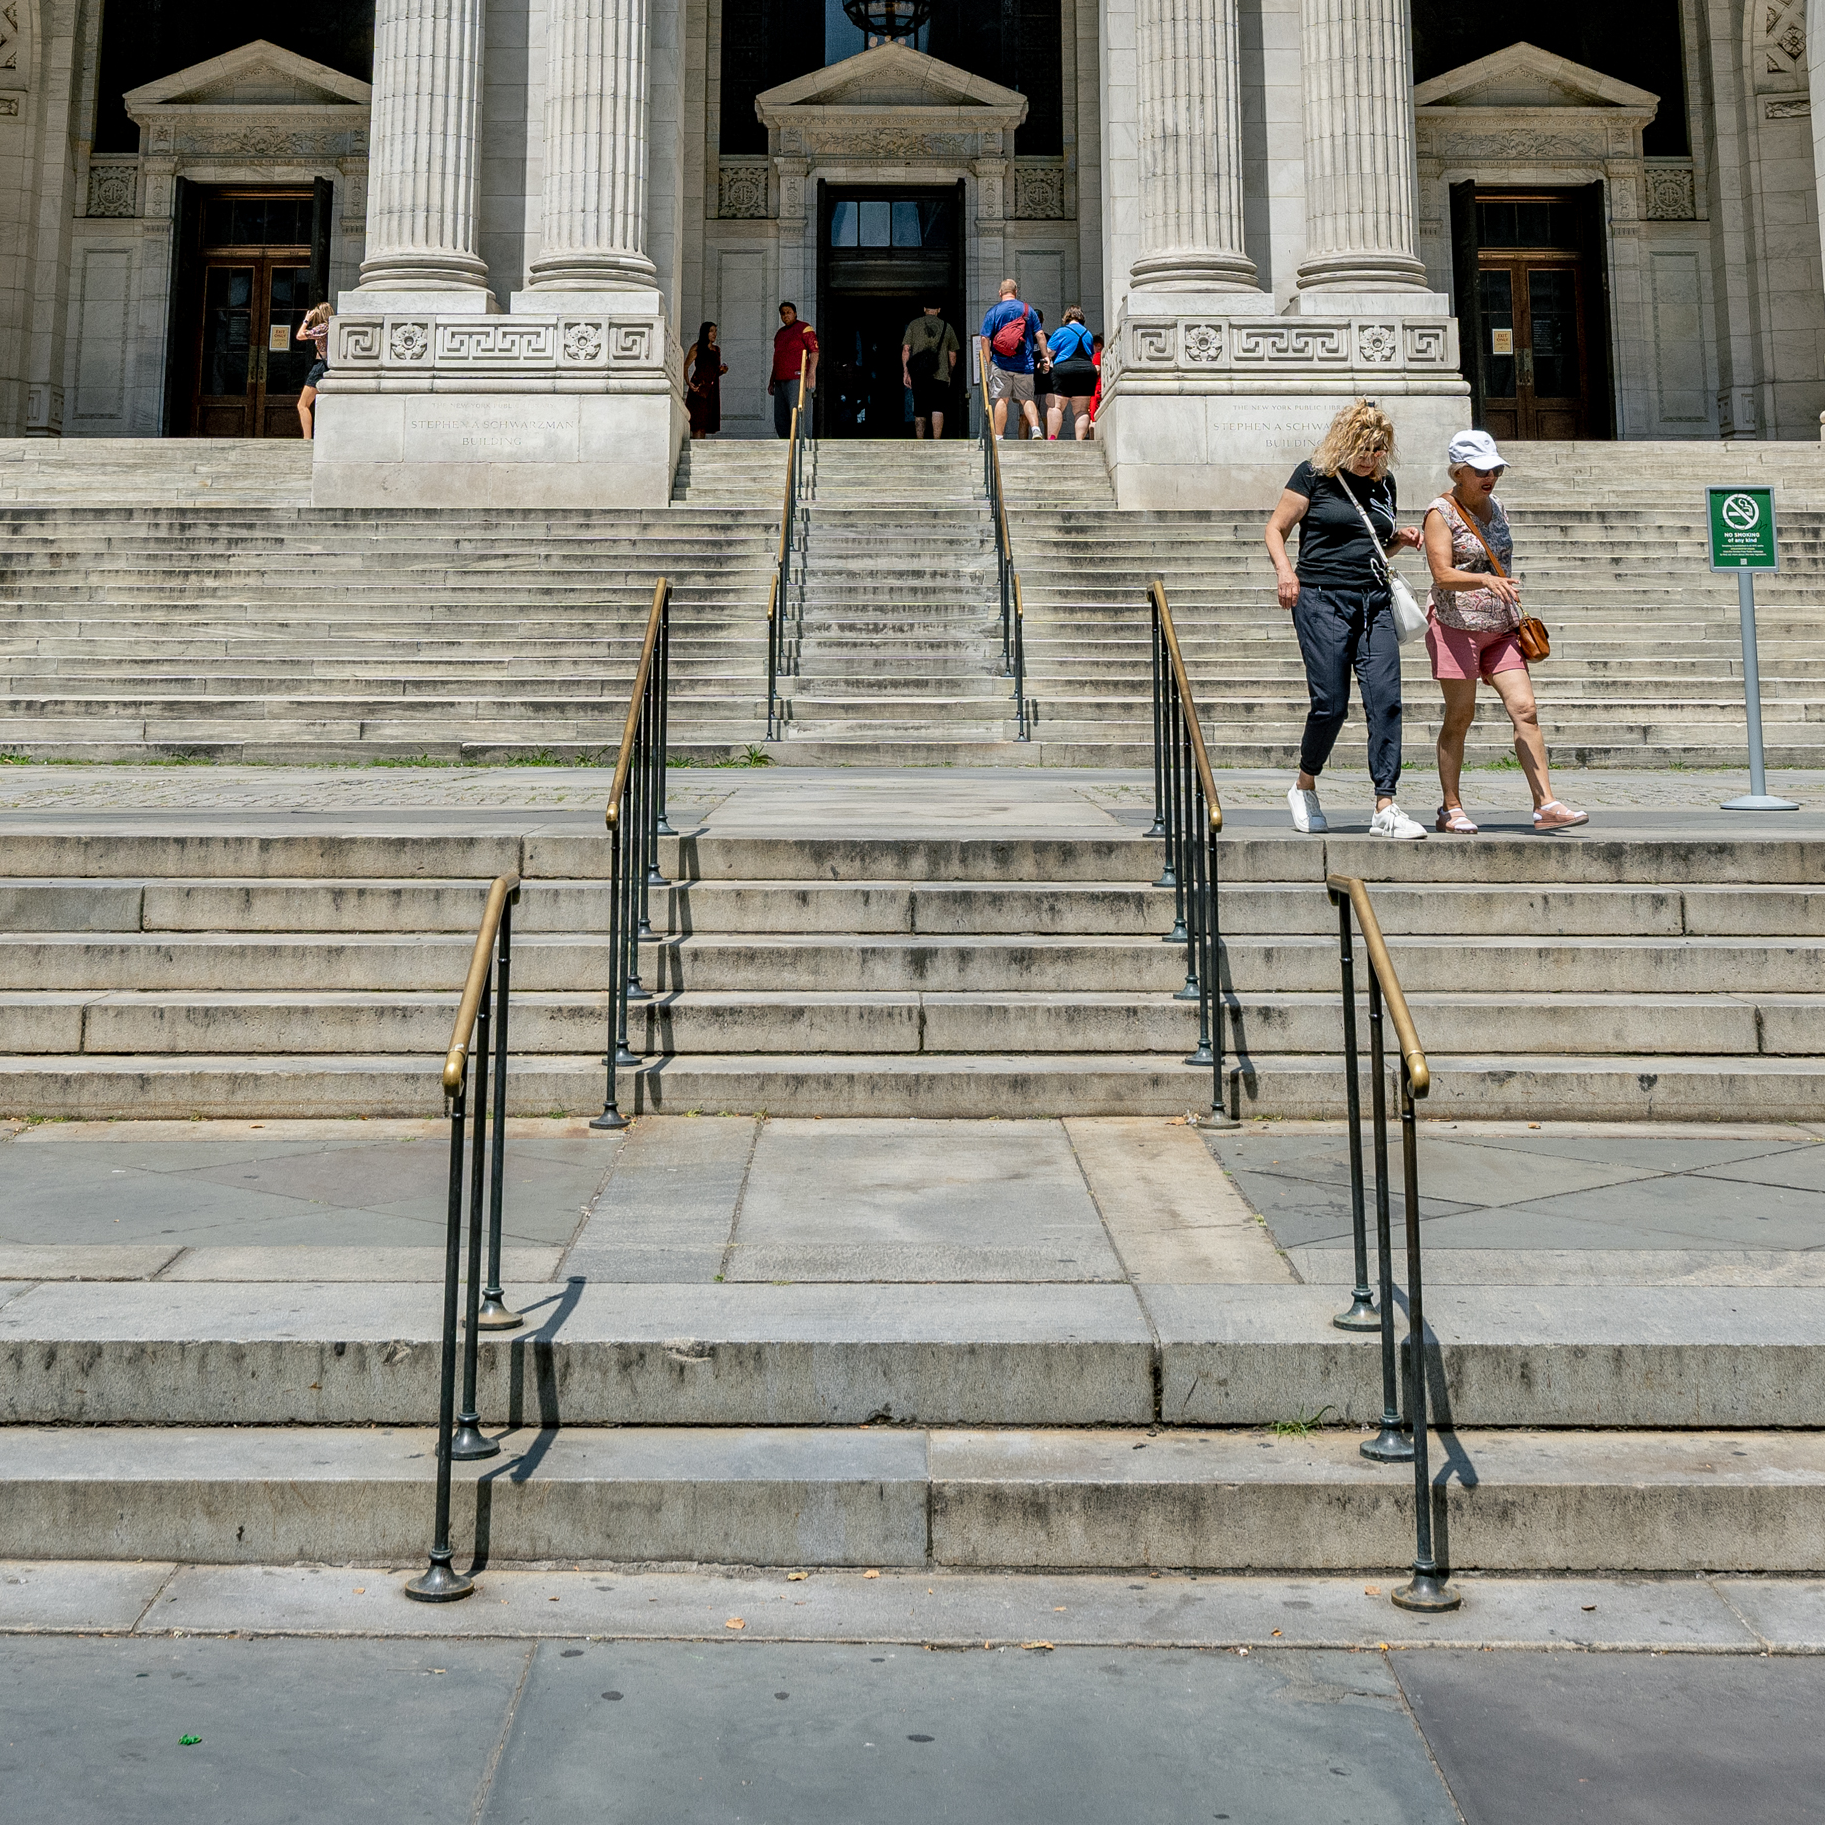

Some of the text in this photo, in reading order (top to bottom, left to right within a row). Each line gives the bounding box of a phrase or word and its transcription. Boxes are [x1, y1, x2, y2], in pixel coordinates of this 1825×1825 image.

[411, 420, 469, 429] STEPHEN
[483, 420, 574, 429] SCHWARZMAN
[1213, 422, 1272, 431] STEPHEN
[1285, 422, 1332, 431] SCHWA
[462, 437, 522, 446] BUILDING
